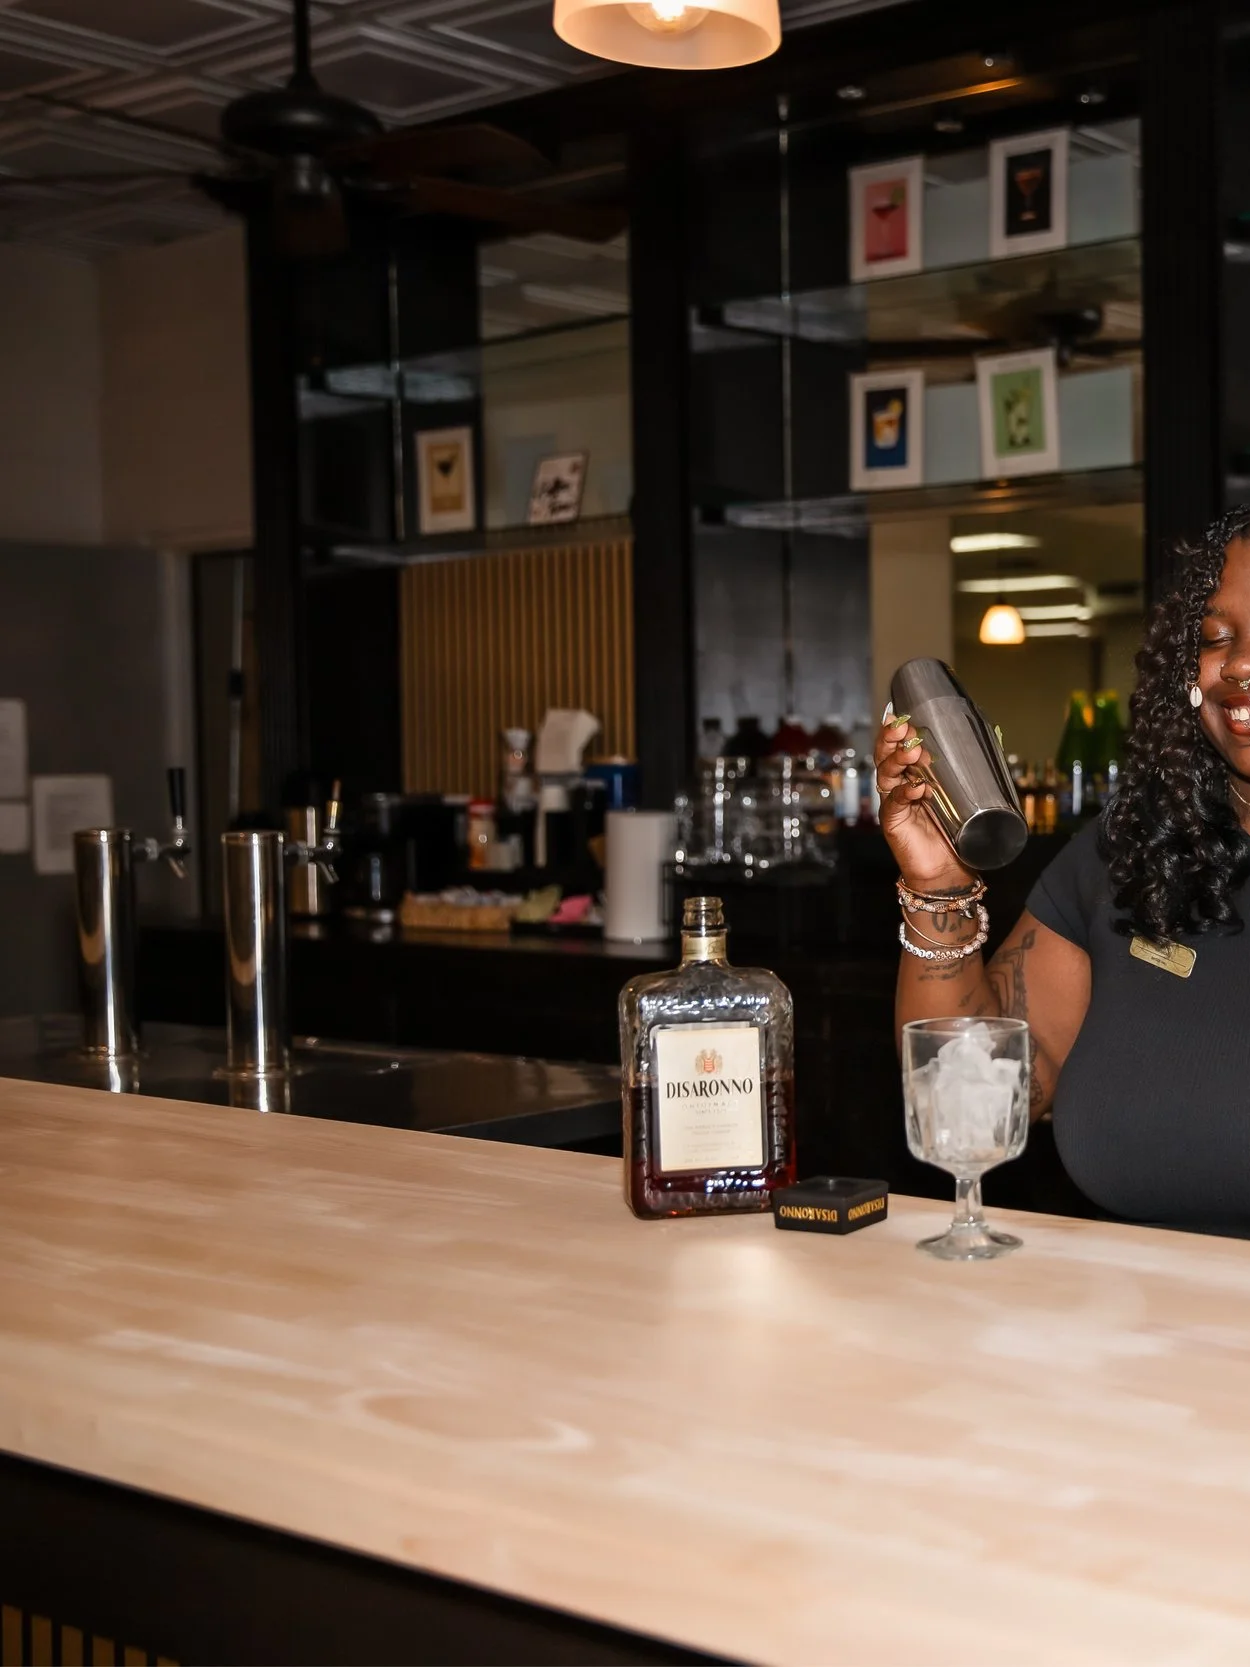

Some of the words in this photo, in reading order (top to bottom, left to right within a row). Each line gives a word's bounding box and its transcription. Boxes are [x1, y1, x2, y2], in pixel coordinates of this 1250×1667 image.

[666, 1077, 753, 1099] DISARONNO
[779, 1205, 838, 1222] DISARONNO
[848, 1197, 885, 1221] DISARONNO
